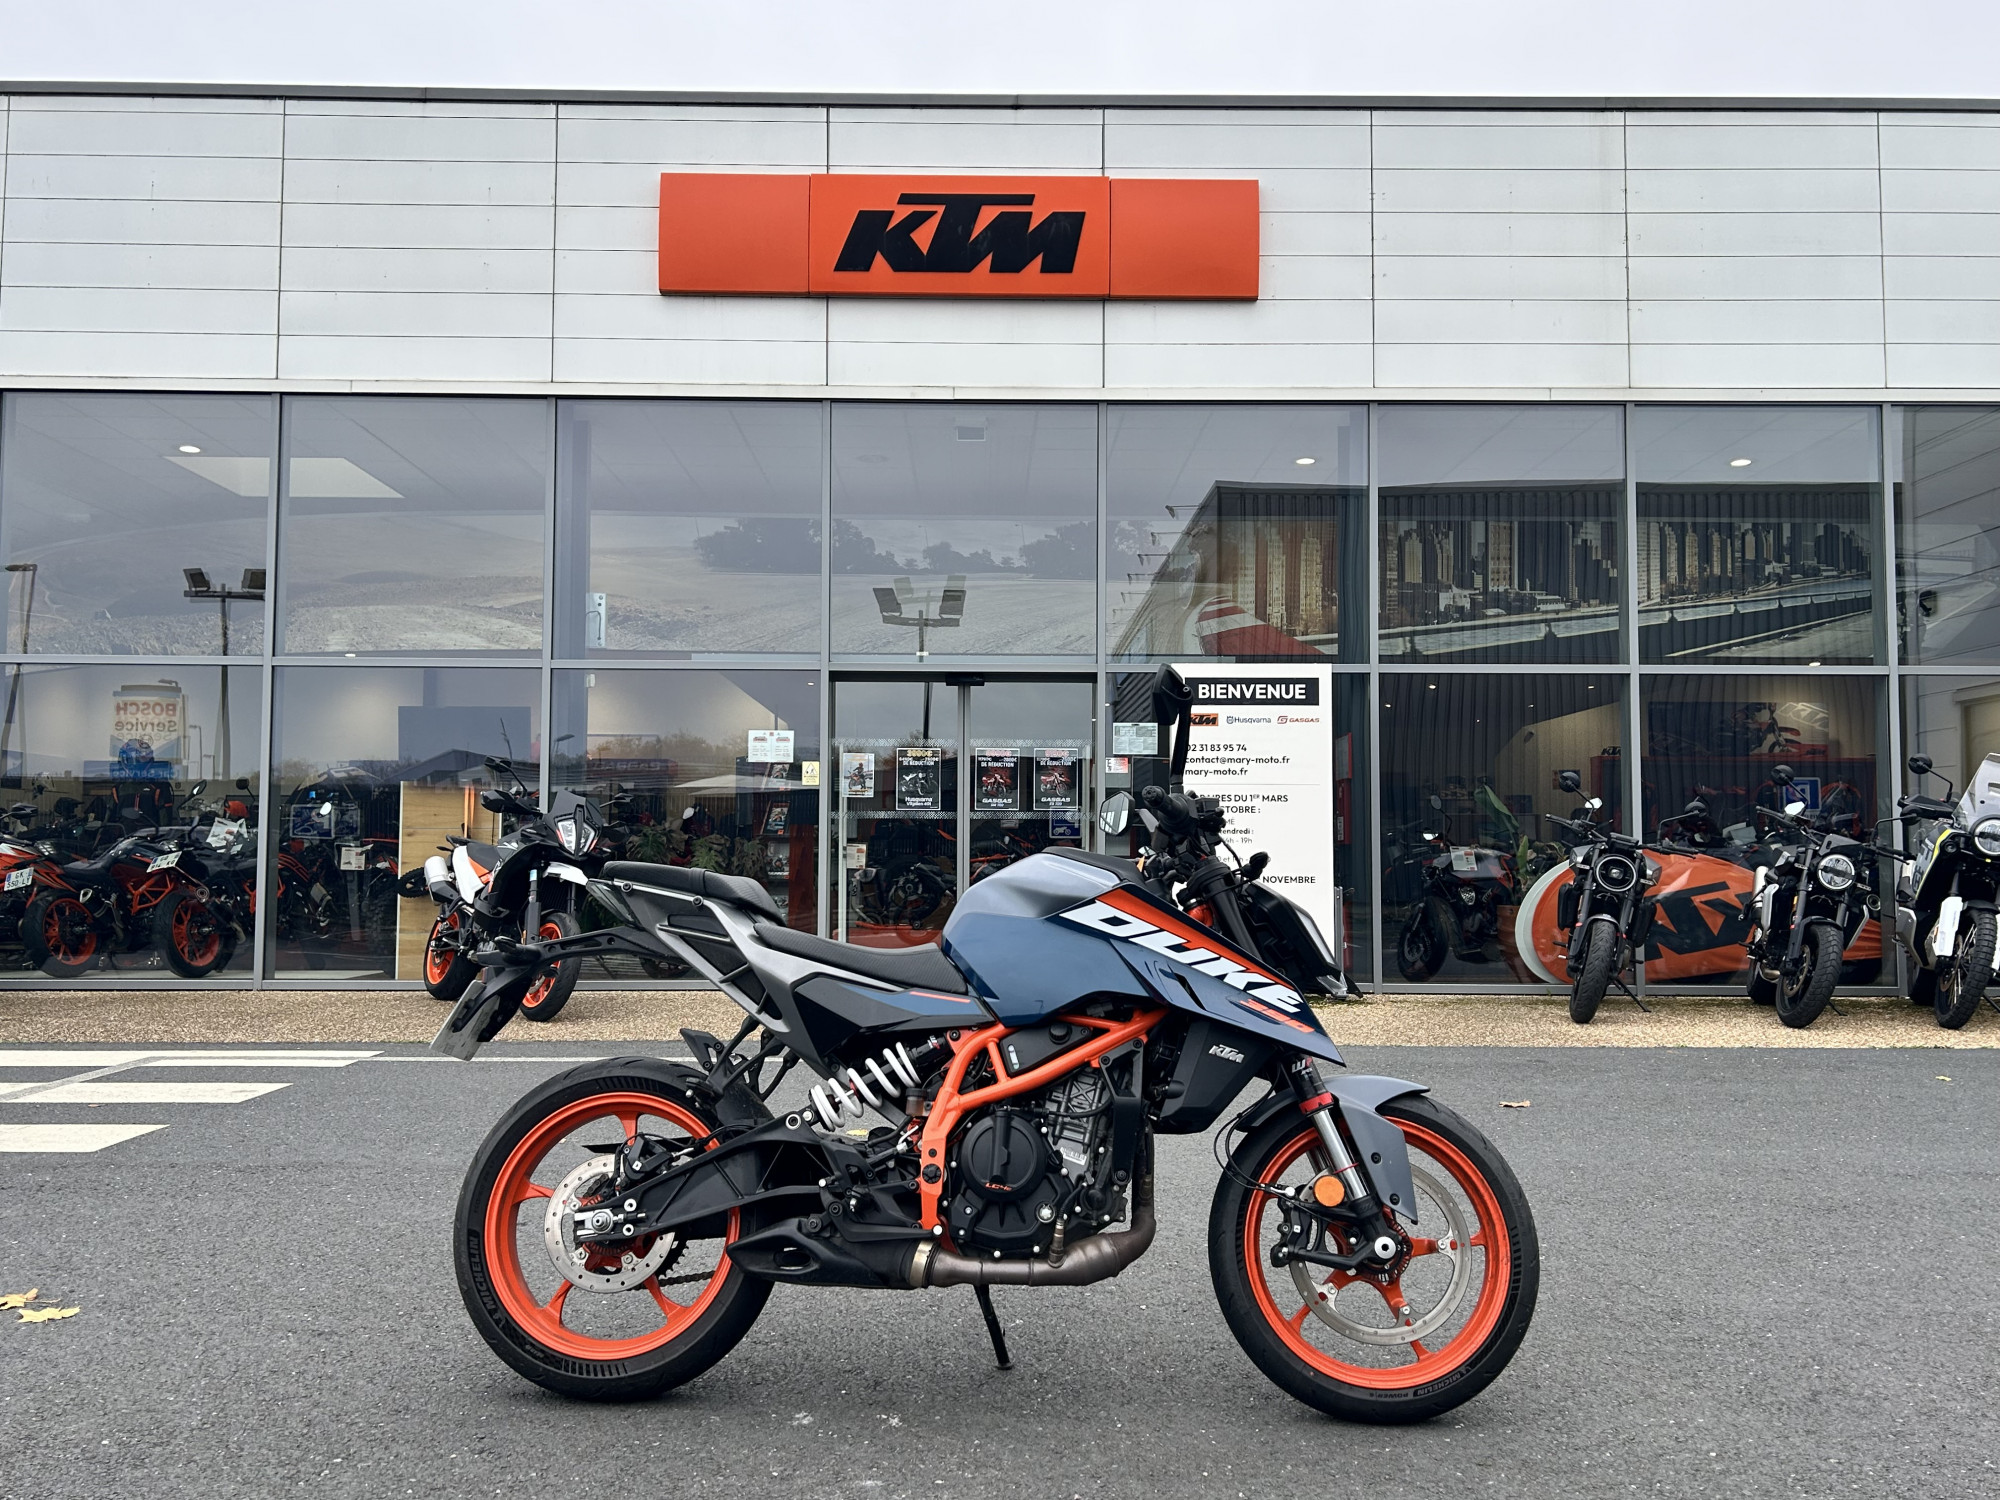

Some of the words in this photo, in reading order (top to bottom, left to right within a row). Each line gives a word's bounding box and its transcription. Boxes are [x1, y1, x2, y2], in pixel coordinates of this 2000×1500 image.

[834, 193, 1086, 273] KTM
[1198, 684, 1306, 699] BIENVENUE
[1190, 714, 1217, 724] KTM
[1234, 716, 1271, 724] Husqvarna
[1186, 756, 1290, 765] contact@mary-moto.fr
[1185, 768, 1248, 777] mary-moto.fr
[1262, 876, 1317, 884] NOVEMBRE
[1059, 899, 1303, 1013] DUKE
[1208, 1044, 1245, 1064] KTM
[469, 1236, 496, 1310] MICHELIN
[1417, 1372, 1461, 1395] MICHELIN
